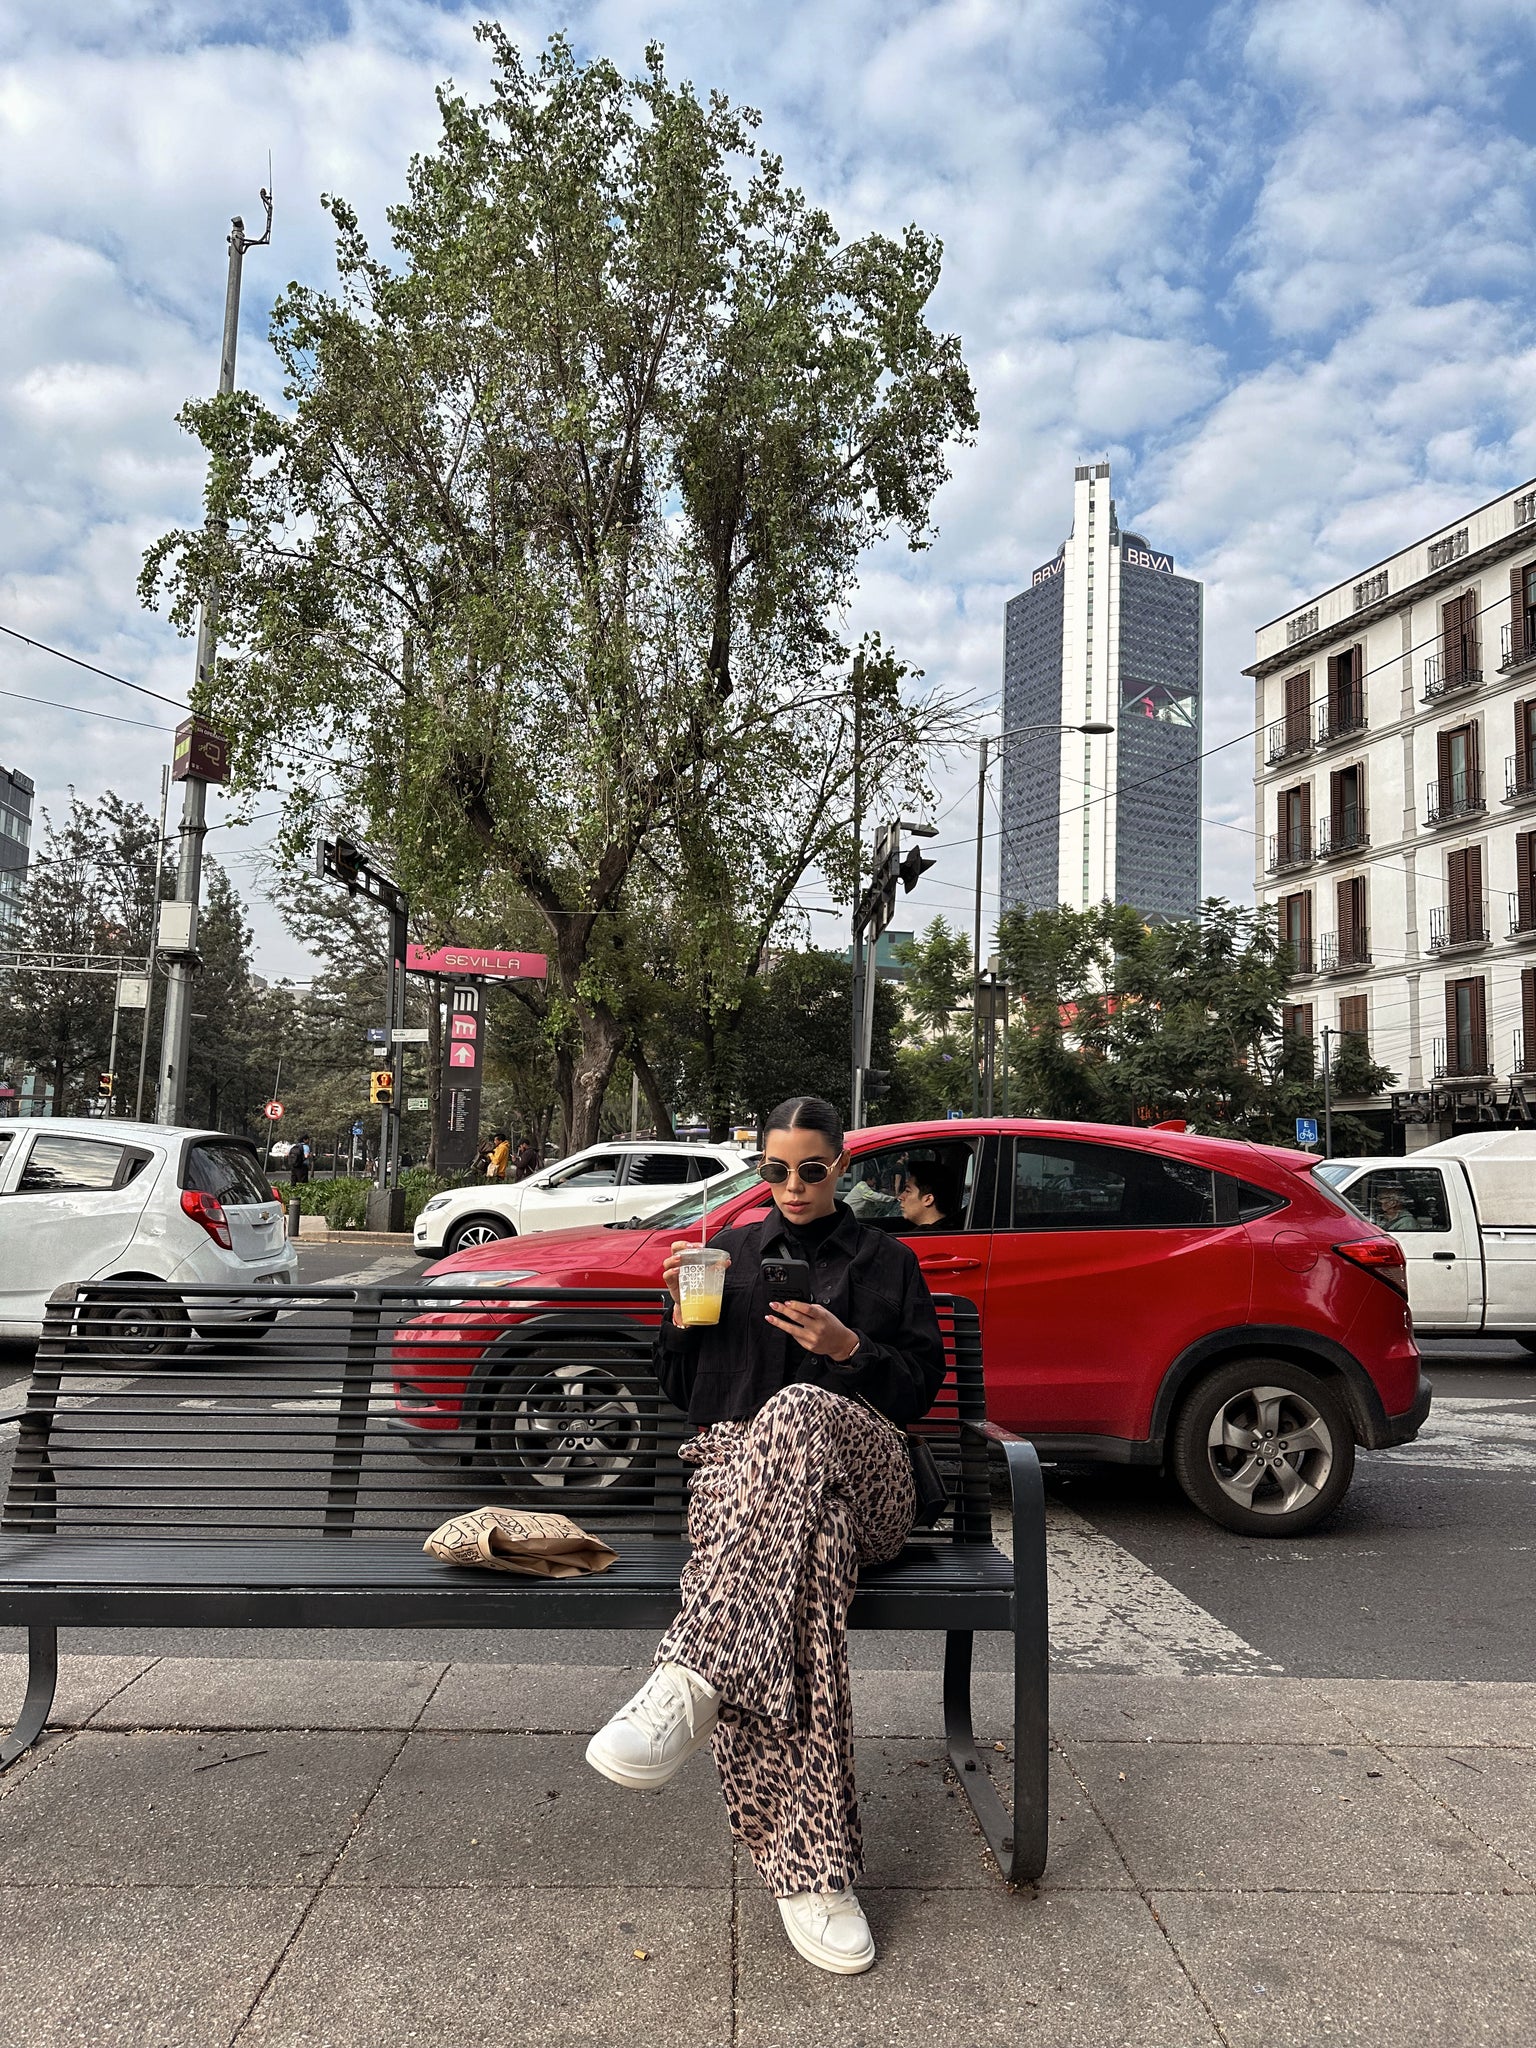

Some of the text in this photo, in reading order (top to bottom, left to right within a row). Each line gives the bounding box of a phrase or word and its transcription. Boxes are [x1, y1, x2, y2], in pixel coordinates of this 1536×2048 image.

[1127, 547, 1172, 573] BBVA
[445, 954, 520, 970] SEVILLA
[270, 1105, 279, 1116] E
[1303, 1120, 1310, 1128] E
